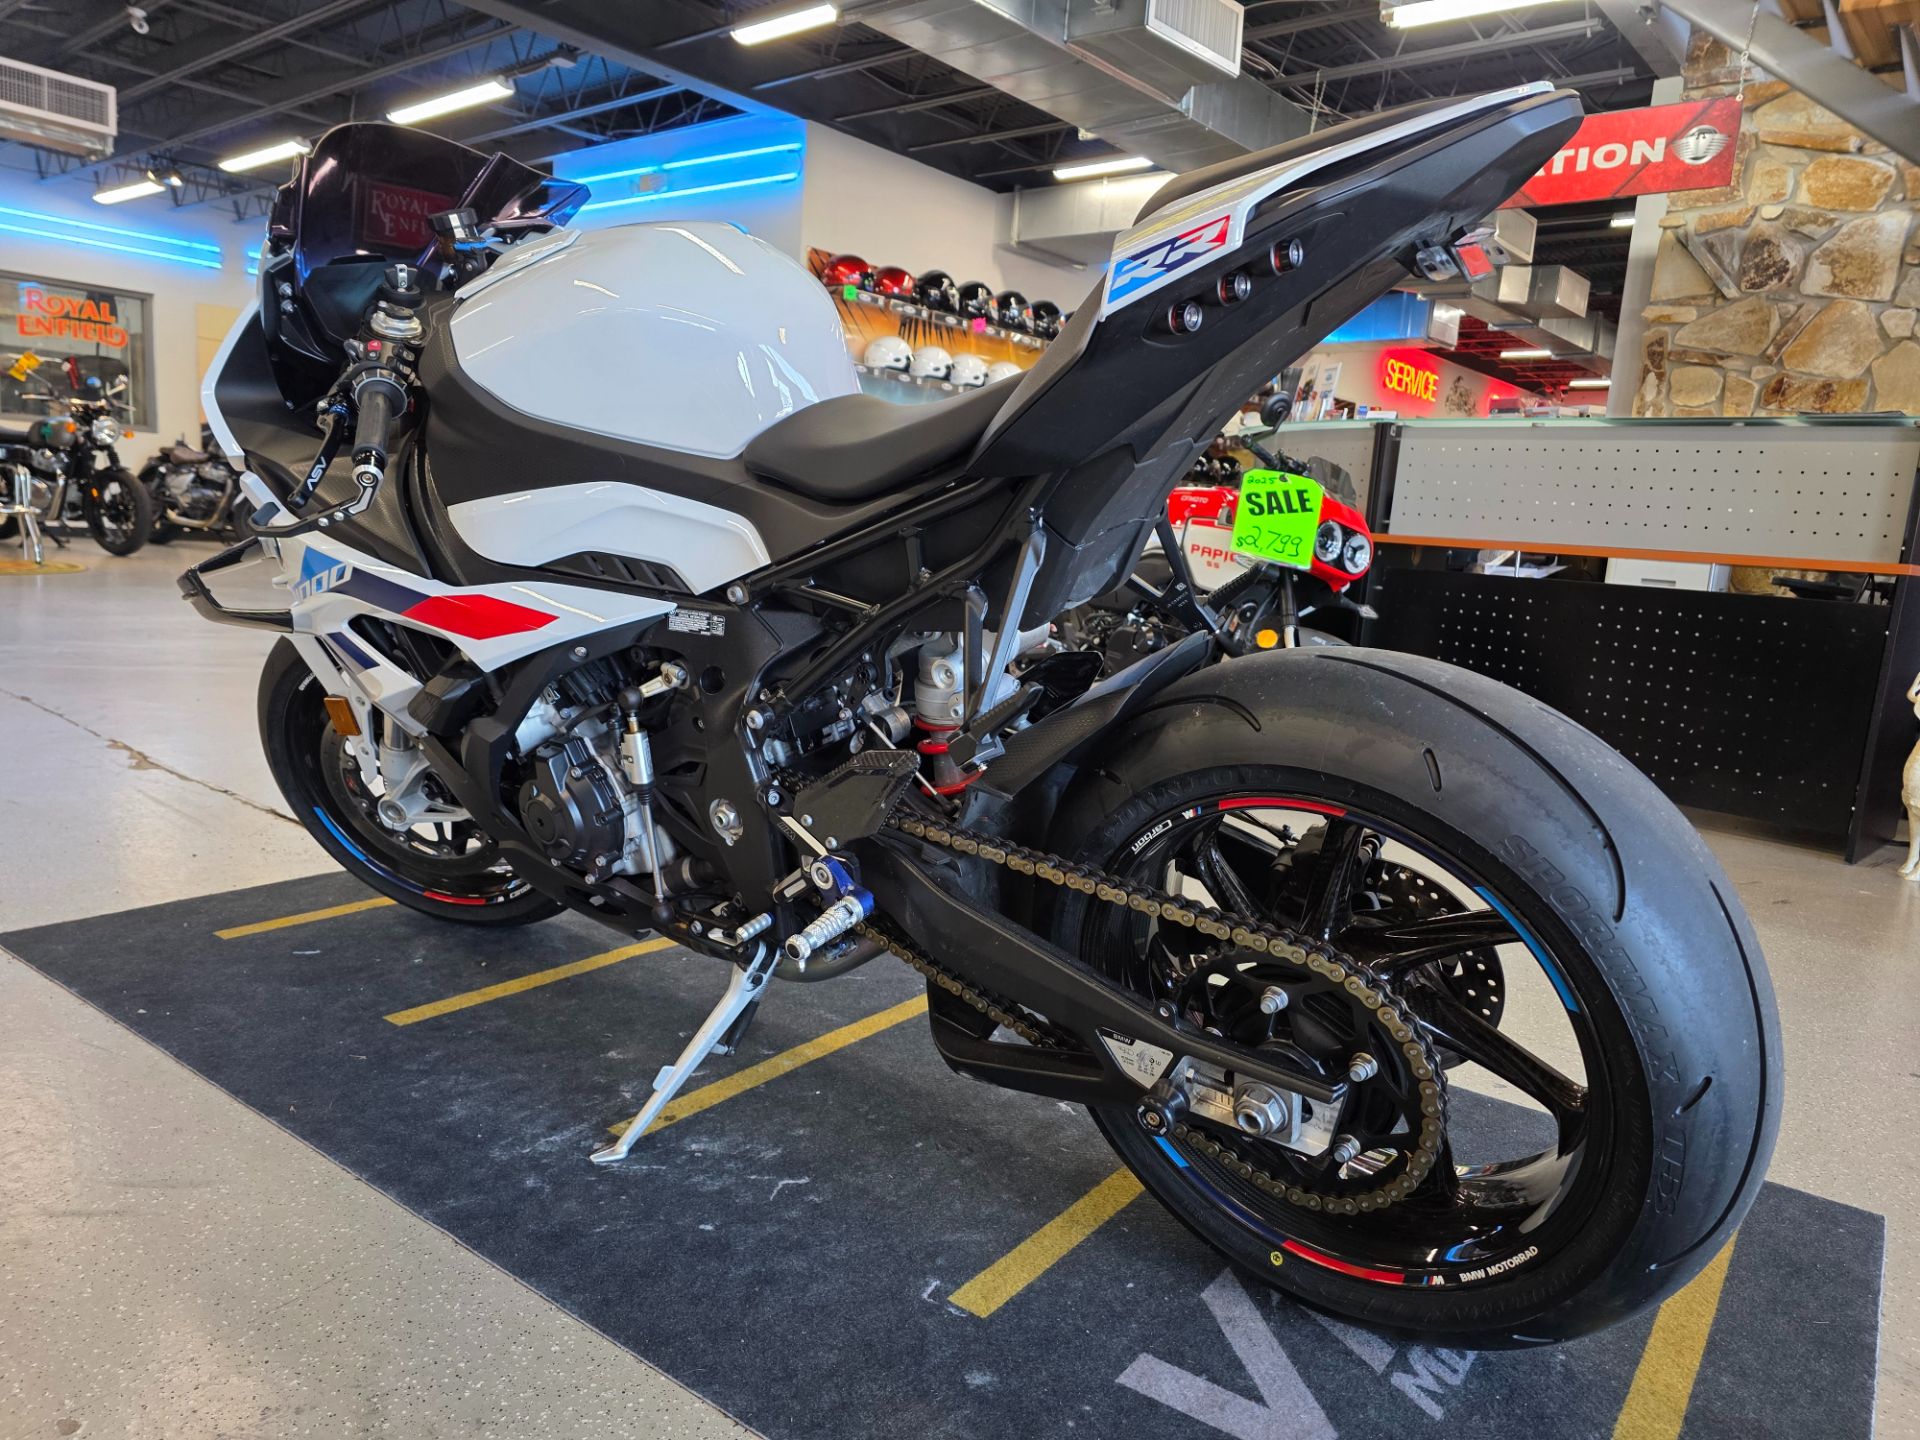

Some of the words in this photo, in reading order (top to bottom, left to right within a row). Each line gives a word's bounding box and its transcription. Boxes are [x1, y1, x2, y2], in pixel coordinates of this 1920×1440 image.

[1533, 137, 1667, 177] TION
[383, 212, 428, 238] ENFI
[25, 287, 117, 324] ROYAL
[16, 313, 129, 349] ENFIELD
[1384, 358, 1439, 402] SERVICE
[306, 455, 327, 492] ASV
[1245, 488, 1314, 517] SALE
[1459, 1268, 1486, 1283] BMW
[1486, 1245, 1539, 1277] MOTORRAD
